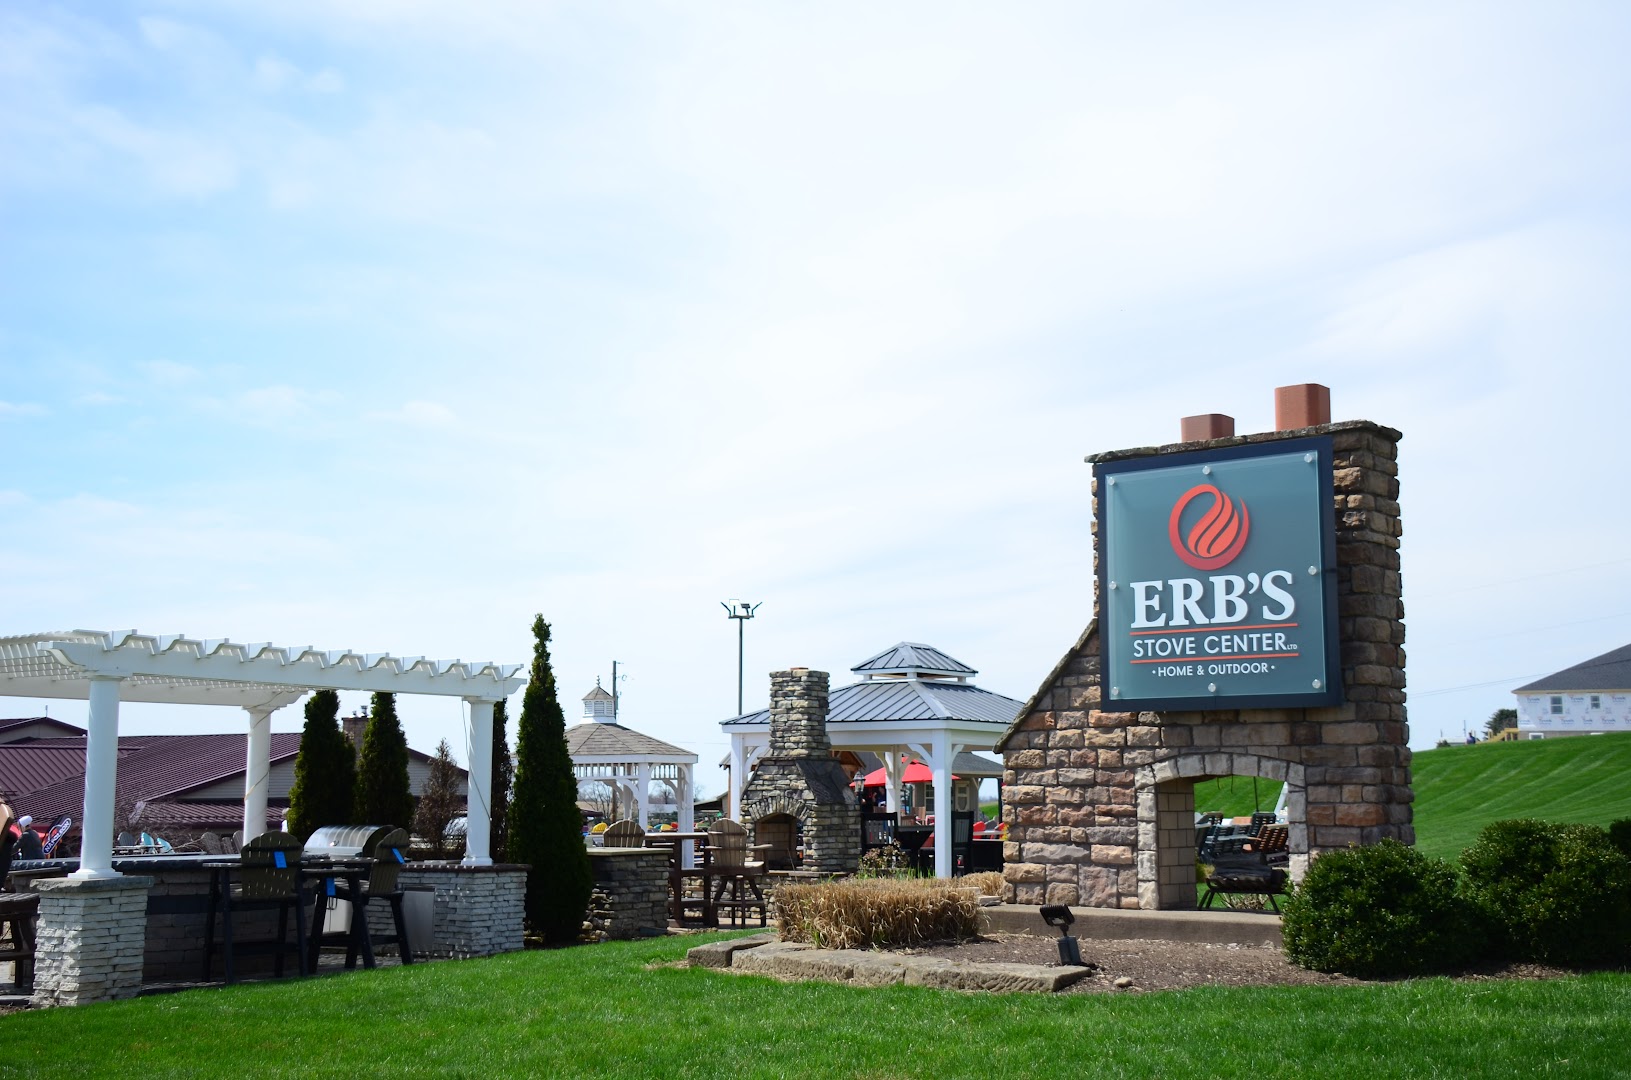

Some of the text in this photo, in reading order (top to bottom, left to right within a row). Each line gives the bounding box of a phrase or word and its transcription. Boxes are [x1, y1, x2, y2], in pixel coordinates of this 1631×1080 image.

[1129, 570, 1296, 629] ERB'S
[1133, 637, 1196, 657] STOVE
[1203, 632, 1287, 654] CENTER
[1157, 662, 1269, 677] HOME & OUTDOOR
